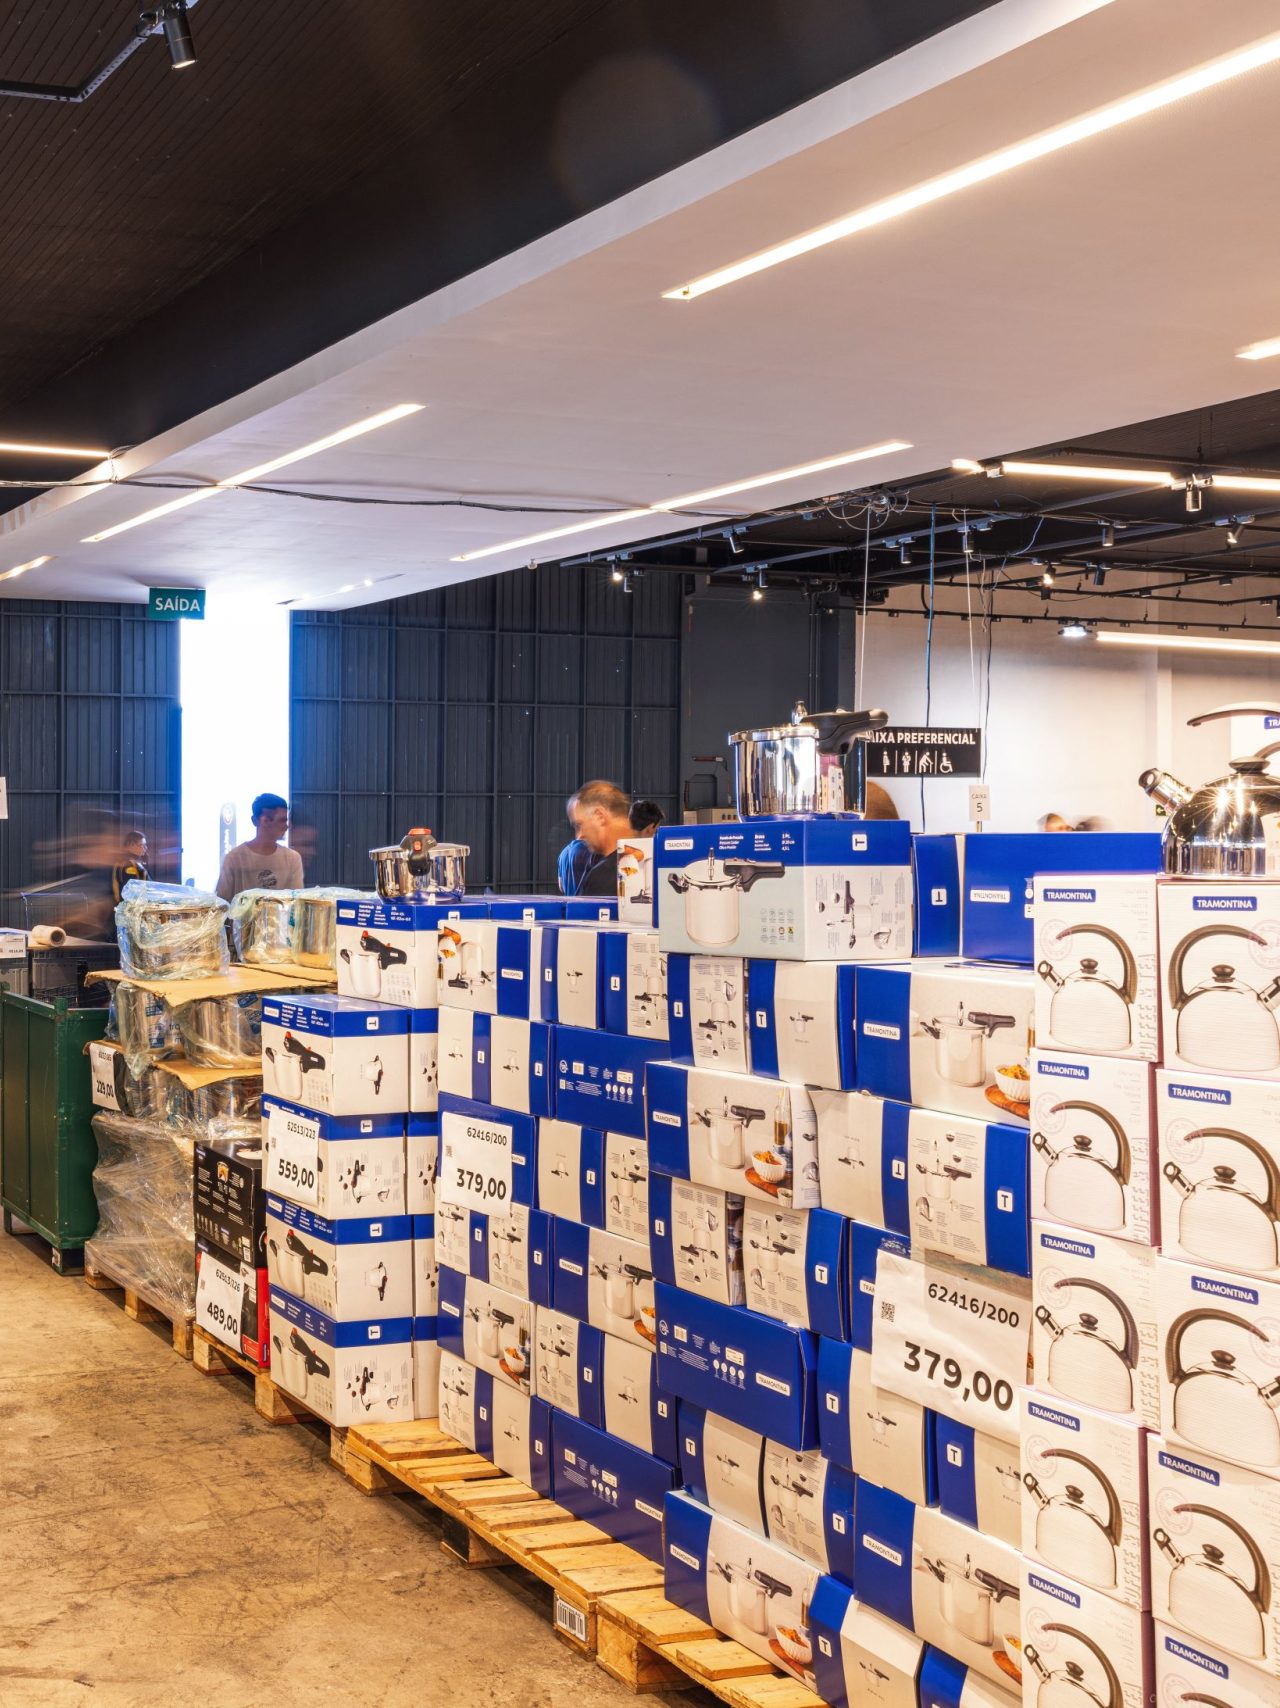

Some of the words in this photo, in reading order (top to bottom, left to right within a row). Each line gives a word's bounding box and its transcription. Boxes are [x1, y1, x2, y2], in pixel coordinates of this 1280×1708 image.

[155, 595, 200, 612] SAÍDA
[897, 732, 976, 744] PREFERENCIAL
[976, 803, 983, 812] 5
[1047, 892, 1092, 900] TRAMONTINA
[1197, 900, 1252, 909] TRAMONTINA
[866, 1026, 898, 1037] TRAMONTINA
[1041, 1064, 1085, 1077] TRAMONTINA
[96, 1079, 115, 1099] 229,00
[1172, 1087, 1226, 1102] TRAMONTINA
[287, 1121, 316, 1140] 62513/223
[467, 1127, 507, 1146] 62416/200
[278, 1158, 314, 1189] 559,00
[456, 1168, 506, 1200] 379,00
[1044, 1238, 1091, 1256] TRAMONTINA
[1196, 1281, 1254, 1302] TRAMONTINA
[928, 1283, 1020, 1328] 62416/200
[207, 1301, 238, 1335] 489,00
[758, 1376, 788, 1393] TRAMONTINA
[904, 1340, 1013, 1412] 379,00
[1031, 1406, 1077, 1428] TRAMONTINA
[1162, 1456, 1216, 1483] TRAMONTINA
[865, 1537, 900, 1563] TRAMONTINA
[1032, 1578, 1077, 1605] TRAMONTINA
[1169, 1642, 1224, 1675] TRAMONTINA
